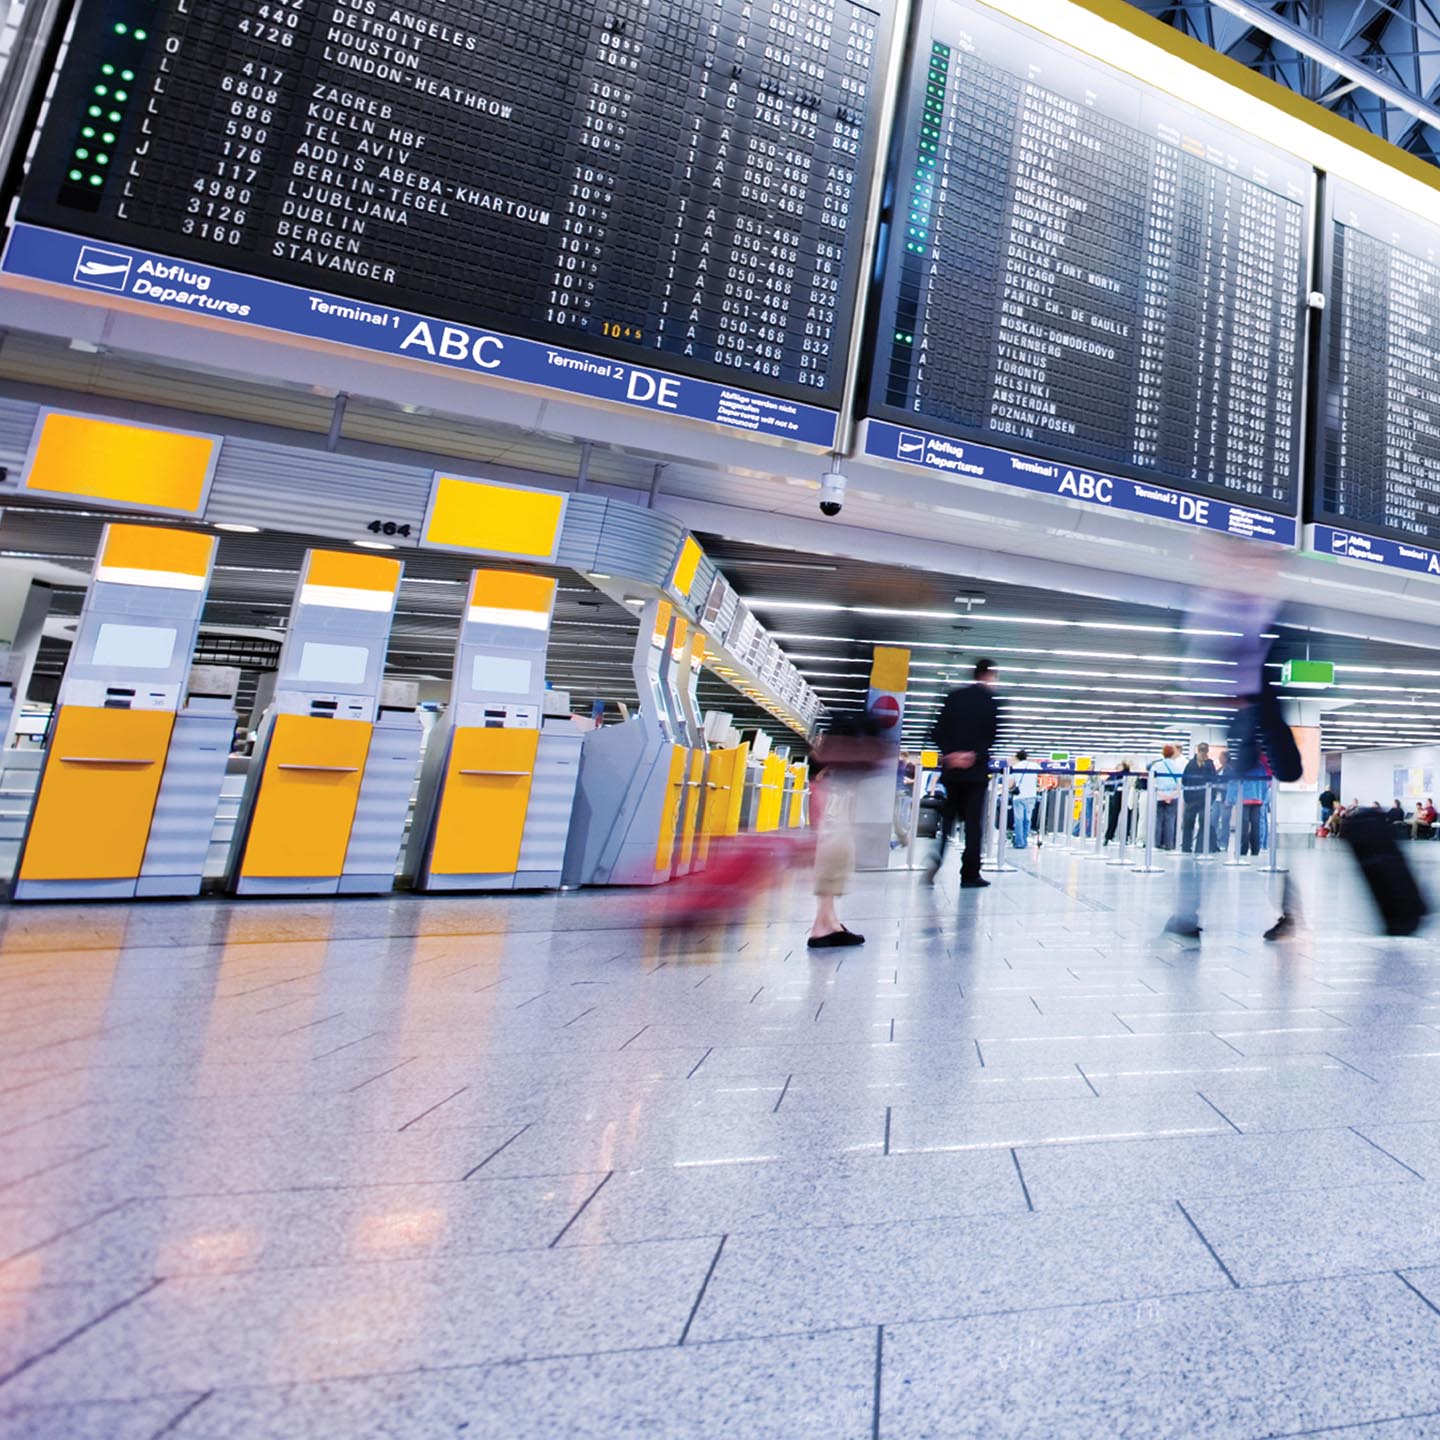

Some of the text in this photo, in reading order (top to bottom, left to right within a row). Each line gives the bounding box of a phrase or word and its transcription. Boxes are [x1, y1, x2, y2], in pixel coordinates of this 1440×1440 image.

[258, 5, 298, 28] 440
[328, 27, 420, 70] HOUSTON
[744, 170, 806, 200] 050-468
[824, 197, 848, 214] C16
[332, 9, 422, 50] DETROIT
[747, 155, 808, 184] 050-468
[826, 183, 850, 199] A53
[390, 9, 476, 50] ANGELES
[750, 139, 811, 169] 050-468
[828, 167, 852, 184] A59
[238, 19, 294, 48] 4726
[324, 46, 513, 118] LONDON-HEATHROW
[741, 186, 803, 215] 050-468
[821, 213, 846, 230] B60
[756, 108, 816, 139] 765-772
[833, 136, 857, 154] B42
[757, 92, 817, 124] 050-468
[835, 122, 859, 139] B28
[222, 76, 278, 104] 6808
[308, 103, 376, 135] KOELN
[389, 128, 426, 150] HBF
[733, 234, 797, 262] 050-468
[816, 258, 831, 273] T6
[243, 62, 284, 86] 417
[312, 83, 393, 119] ZAGREB
[736, 218, 799, 246] 051-468
[817, 243, 842, 260] B61
[1018, 163, 1058, 188] BILBAO
[230, 101, 273, 124] 686
[305, 122, 341, 146] TEL
[358, 139, 410, 164] AVIV
[730, 250, 794, 278] 050-468
[812, 274, 837, 292] B20
[1014, 190, 1068, 219] BUKAREST
[1016, 176, 1088, 213] DUESSELDORF
[226, 120, 267, 144] 590
[296, 142, 365, 172] ADDIS
[380, 166, 551, 226] ABEBA-KHARTOUM
[728, 267, 792, 294] 050-468
[810, 290, 836, 308] B23
[1013, 204, 1067, 232] BUDAPEST
[223, 141, 262, 164] 176
[292, 161, 449, 216] BERLIN-TEGEL
[725, 283, 790, 311] 050-468
[808, 307, 833, 323] A13
[1010, 232, 1058, 257] KOLKATA
[1012, 218, 1065, 246] NEW YORK
[217, 162, 256, 184] 117
[288, 181, 408, 226] LJUBLJANA
[722, 300, 786, 327] 051-468
[805, 322, 831, 339] B11
[137, 259, 211, 290] Abflug
[194, 178, 251, 204] 4980
[282, 200, 366, 234] DUBLIN
[720, 317, 784, 344] 050-468
[803, 338, 830, 356] B32
[1006, 260, 1055, 284] CHICAGO
[1008, 245, 1121, 293] DALLAS FORT WORTH
[132, 280, 251, 318] Departures
[188, 198, 246, 225] 3126
[277, 221, 360, 254] BERGEN
[717, 334, 782, 360] 050-468
[800, 355, 817, 369] B1
[1005, 273, 1054, 298] DETROIT
[182, 219, 241, 245] 3160
[273, 241, 397, 284] STAVANGER
[714, 351, 780, 377] 050-468
[799, 372, 824, 388] B13
[309, 297, 400, 329] Terminal 1
[1004, 288, 1130, 336] PARIS CH. DE GAULLE
[400, 321, 504, 370] ABC
[999, 330, 1062, 358] NUERNBERG
[1000, 316, 1115, 360] MOSKAU-DOMODEDOVO
[546, 350, 624, 380] Terminal 2
[997, 360, 1046, 383] TORONTO
[998, 345, 1047, 368] VILNIUS
[626, 371, 682, 409] DE
[992, 389, 1056, 414] AMSTERDAM
[994, 374, 1050, 398] HELSINKI
[775, 420, 788, 428] not
[788, 422, 798, 430] be
[990, 404, 1076, 434] POZNAN/POSEN
[990, 418, 1034, 438] DUBLIN
[926, 453, 984, 476] Departures
[927, 439, 964, 458] Abflug
[1010, 458, 1058, 478] Terminal 1
[1058, 470, 1113, 504] ABC
[1134, 485, 1178, 505] Terminal 2
[1178, 496, 1210, 524] DE
[367, 520, 412, 538] 464
